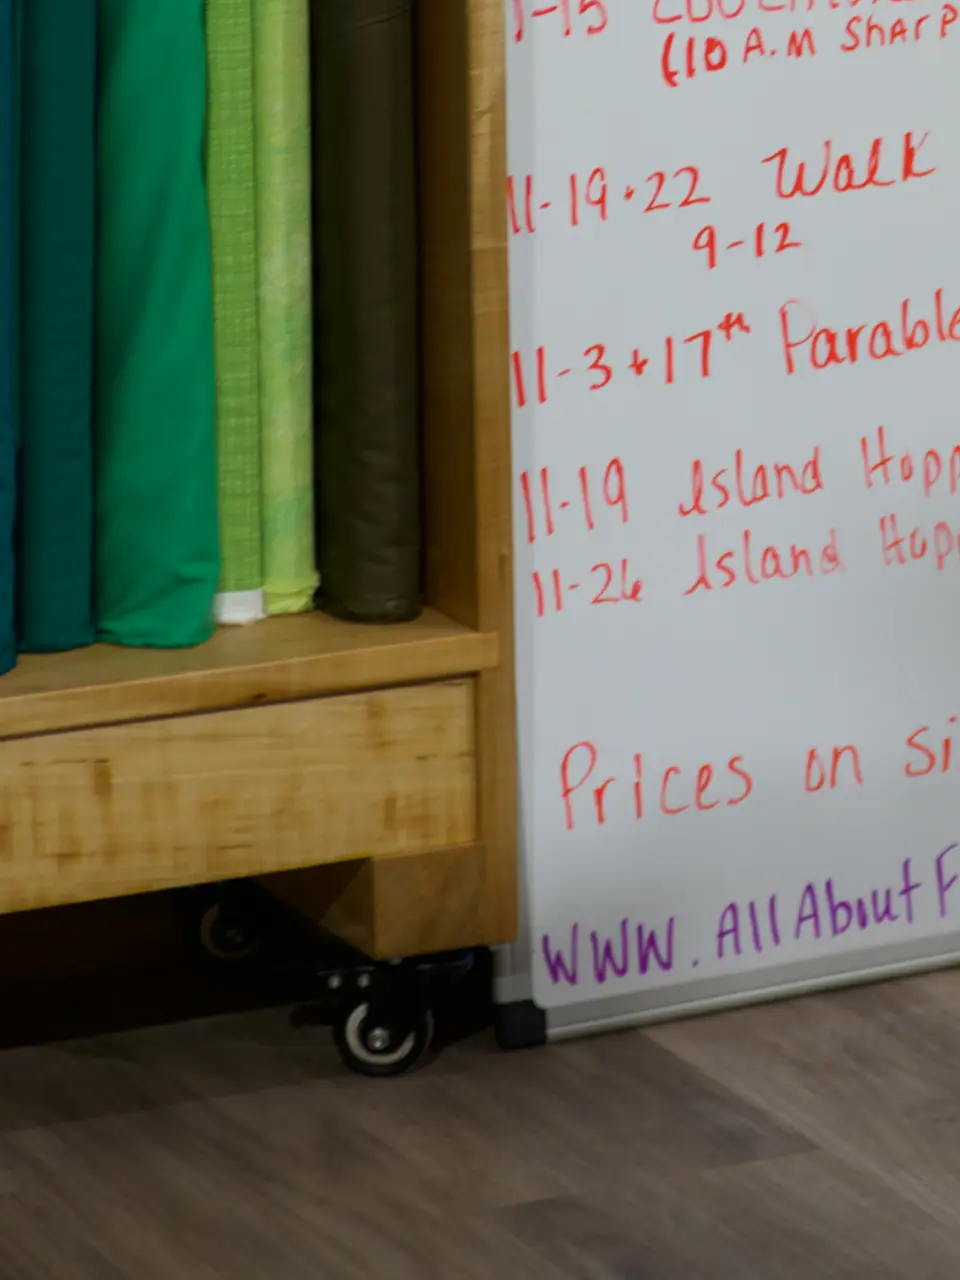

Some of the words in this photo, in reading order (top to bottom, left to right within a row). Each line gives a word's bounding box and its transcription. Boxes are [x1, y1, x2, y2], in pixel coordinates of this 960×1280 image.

[761, 130, 937, 200] Walk
[519, 456, 631, 544] 11-19
[677, 445, 825, 517] Island
[531, 558, 644, 618] 11-26
[683, 527, 848, 597] Island
[560, 740, 754, 830] Prices
[804, 743, 864, 794] on
